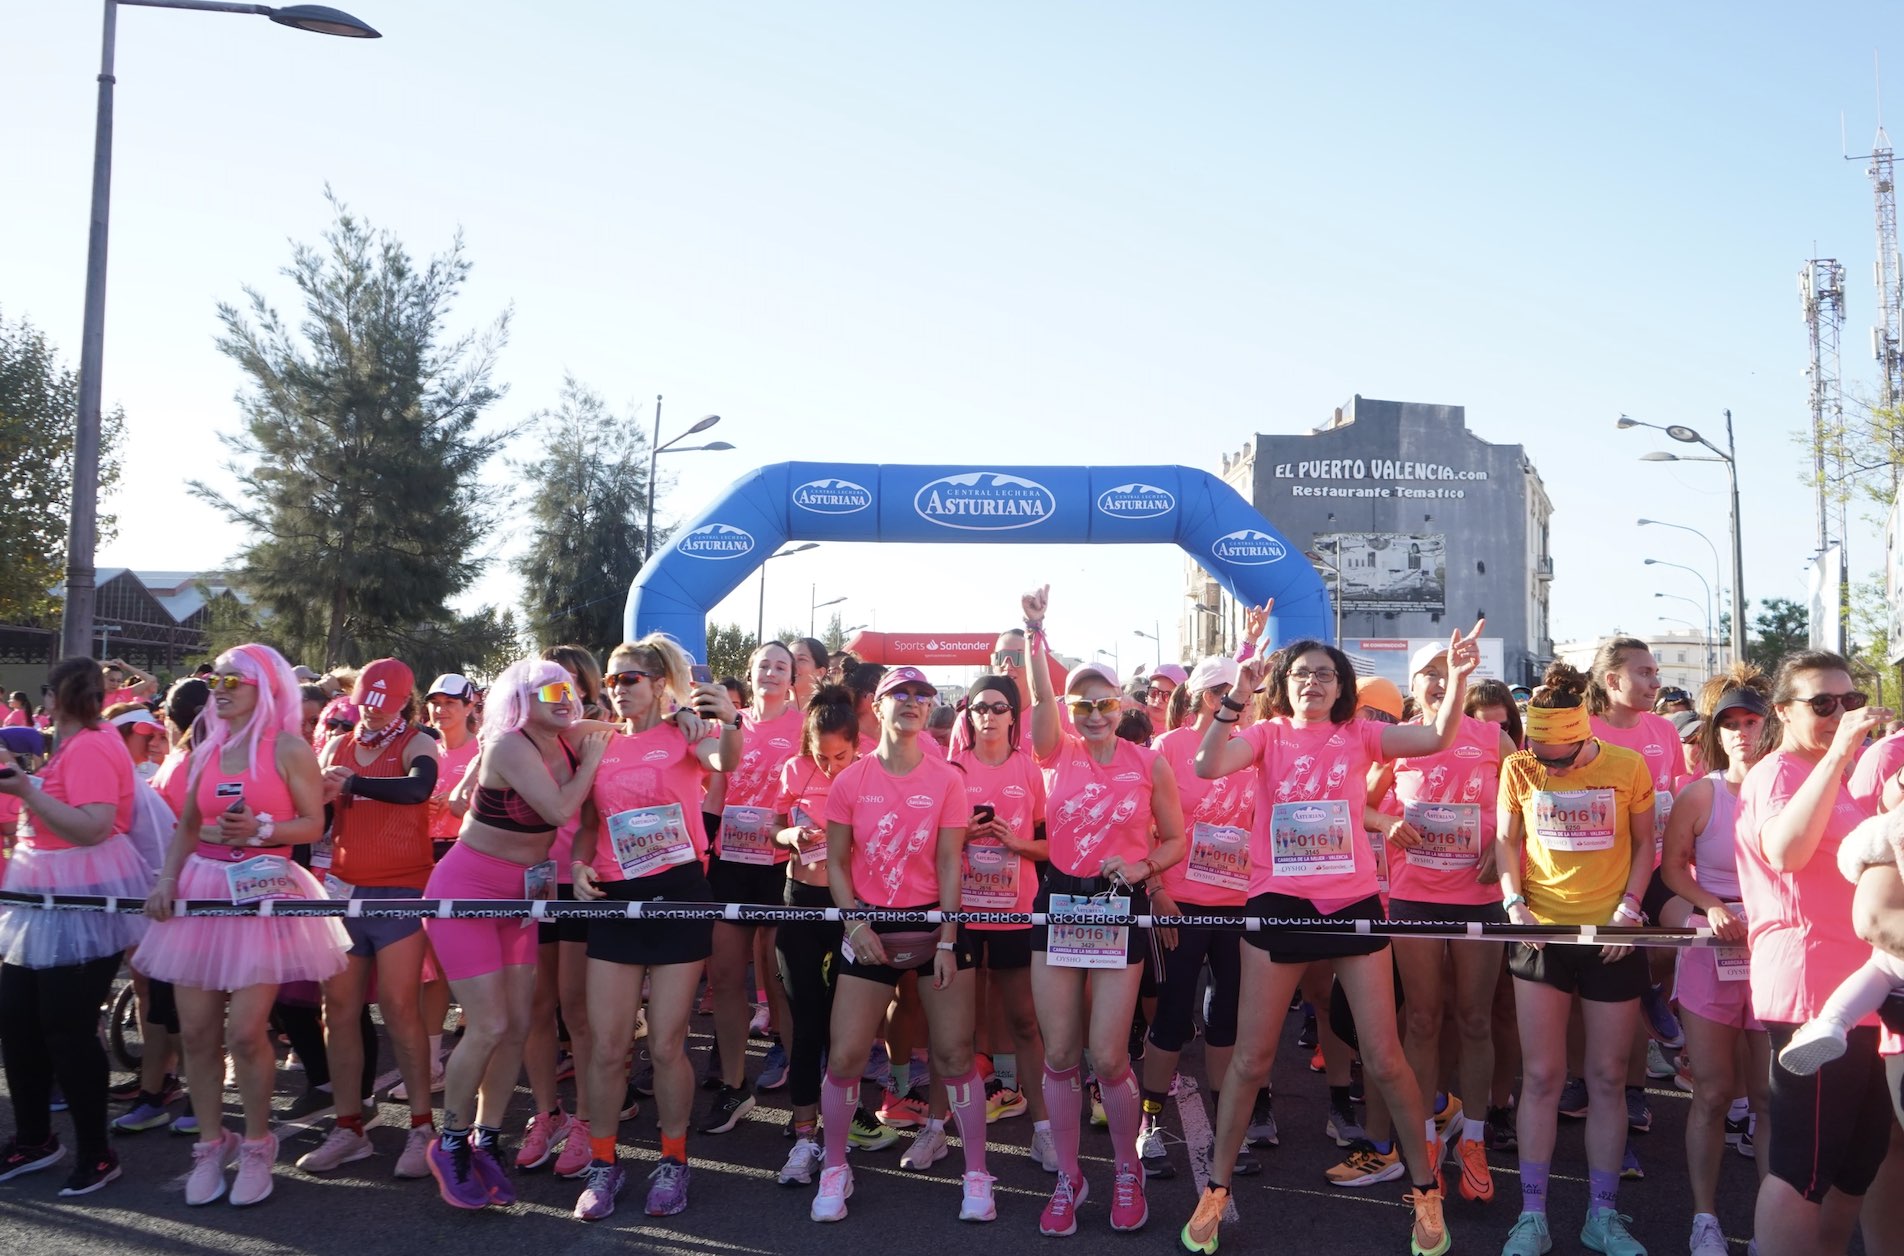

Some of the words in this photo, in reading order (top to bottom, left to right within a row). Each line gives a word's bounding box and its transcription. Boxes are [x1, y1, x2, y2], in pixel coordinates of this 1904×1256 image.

[1275, 463, 1295, 479] EL
[1298, 459, 1366, 480] PUERTO
[798, 489, 866, 506] ASTURIANA
[946, 489, 992, 497] CENTRAL
[995, 489, 1041, 497] LECHERA
[1292, 485, 1391, 498] Restaurante
[924, 489, 1046, 516] ASTURIANA
[1103, 495, 1170, 510] ASTURIANA
[681, 537, 749, 551] ASTURIANA
[1218, 542, 1283, 556] ASTURIANA
[894, 640, 925, 652] Sports
[939, 640, 990, 651] Santander
[1557, 810, 1590, 822] 016
[636, 832, 665, 848] 016
[736, 831, 757, 842] 016
[1297, 834, 1328, 847] 016
[1427, 832, 1456, 845] 016
[1213, 850, 1236, 864] 016
[1281, 865, 1308, 873] OYSHO
[258, 877, 287, 889] 016
[974, 872, 1000, 884] 016
[1075, 927, 1104, 941] 016
